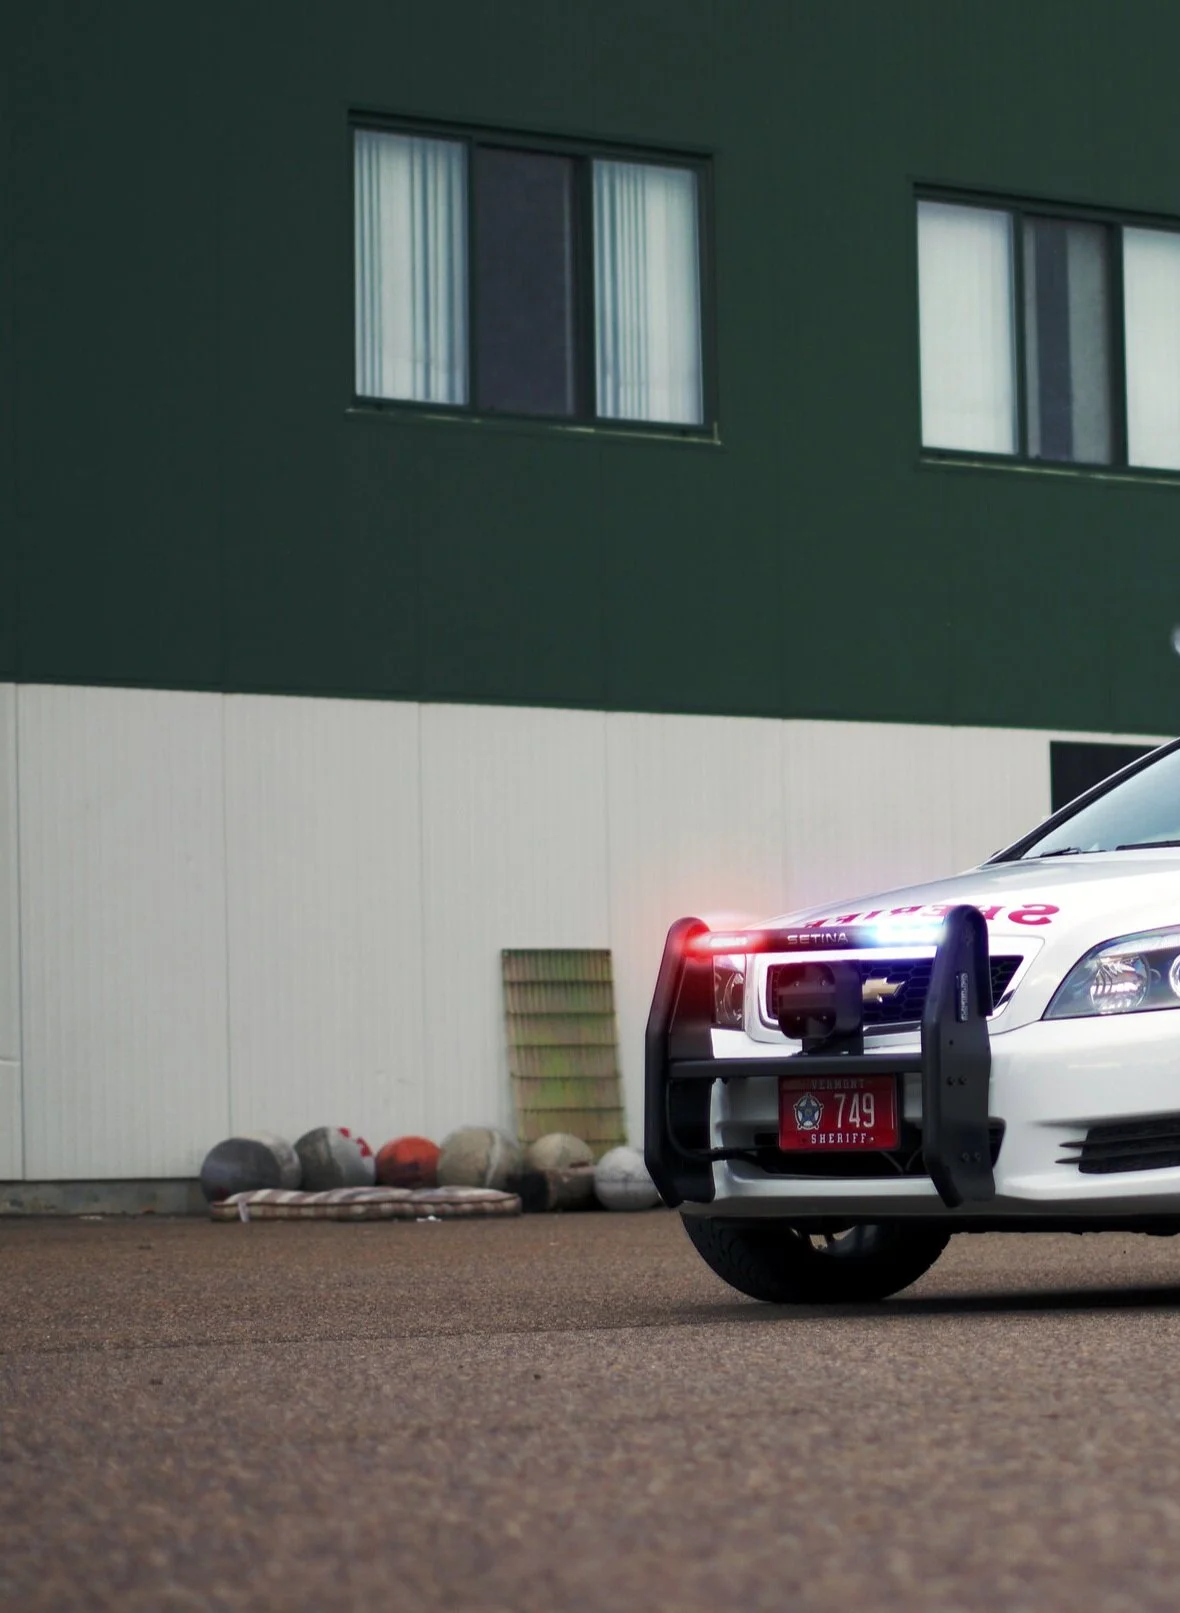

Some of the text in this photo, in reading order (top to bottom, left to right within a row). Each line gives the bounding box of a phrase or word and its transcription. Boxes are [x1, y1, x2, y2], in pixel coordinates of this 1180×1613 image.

[786, 932, 849, 946] SETINA
[811, 1078, 865, 1090] VERMONT
[833, 1092, 875, 1129] 749
[811, 1132, 867, 1144] SHERIFF
